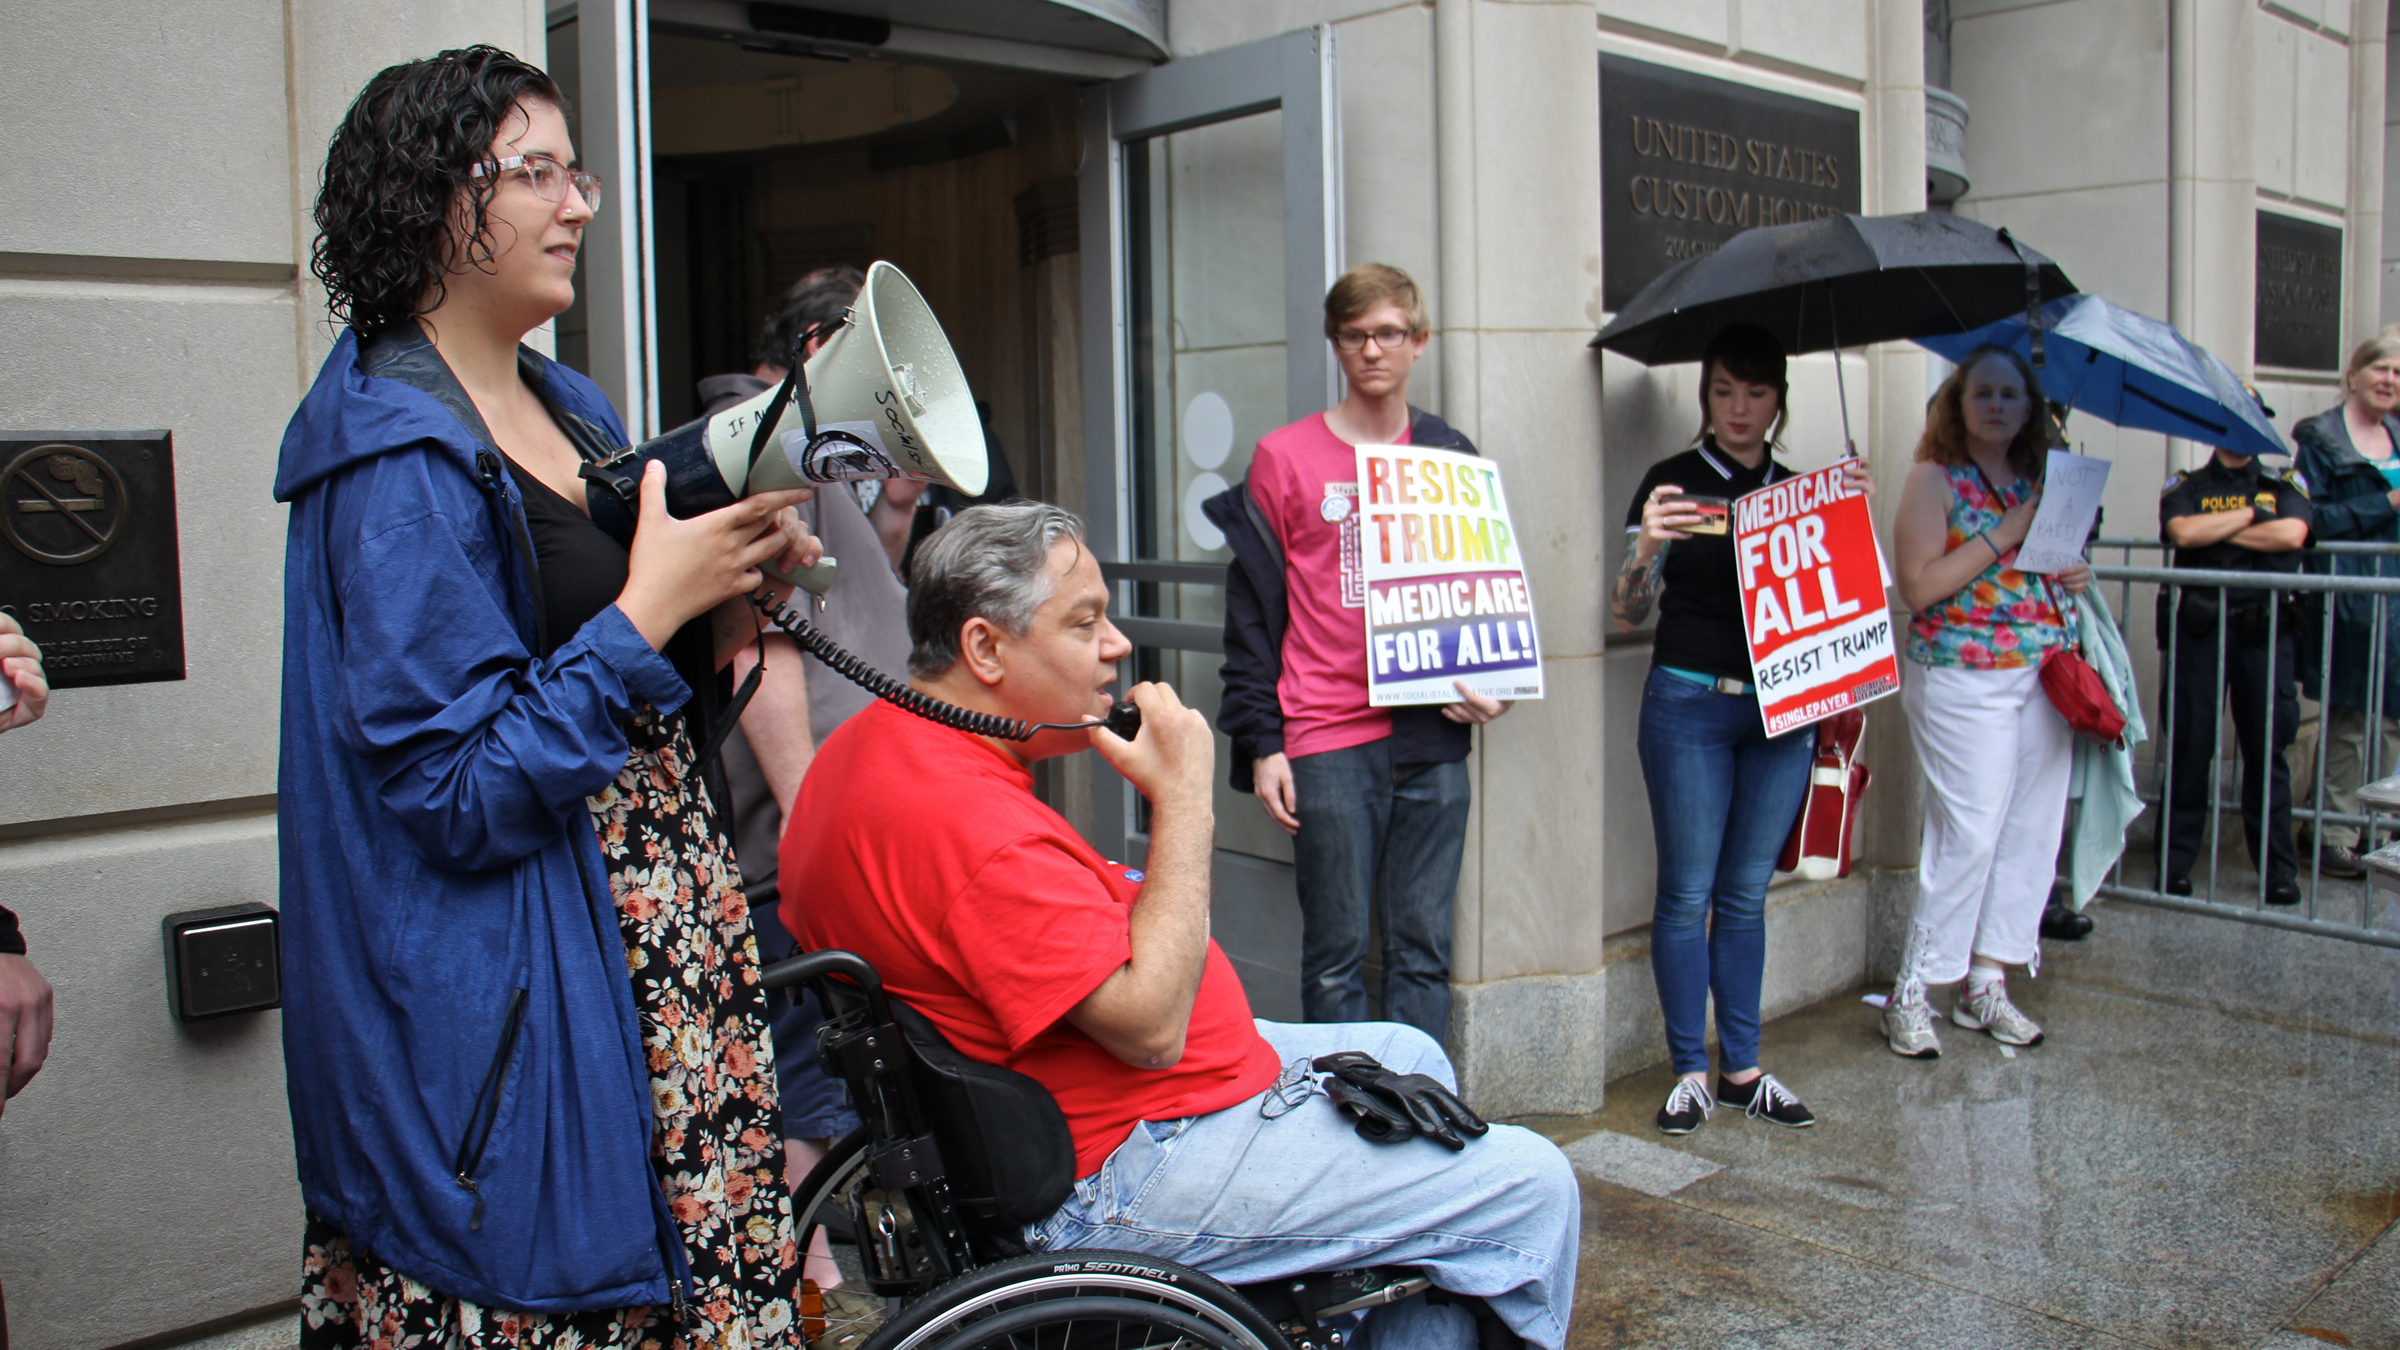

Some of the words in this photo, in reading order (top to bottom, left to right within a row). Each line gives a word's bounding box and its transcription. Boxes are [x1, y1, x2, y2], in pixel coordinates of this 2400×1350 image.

[1632, 115, 1739, 171] UNITED
[1746, 139, 1839, 190] STATES
[1630, 175, 1751, 228] CUSTOM
[1365, 456, 1499, 512] RESIST
[2051, 463, 2097, 488] NOT
[2062, 496, 2073, 514] A
[2201, 494, 2247, 511] POLICE
[1371, 513, 1512, 564] TRUMP
[1740, 514, 1831, 590] FOR
[2036, 519, 2076, 542] PAID
[28, 597, 158, 623] SMOKING
[1369, 577, 1529, 627] MEDICARE
[1752, 565, 1860, 645] ALL
[46, 651, 135, 669] DOORWAYS
[82, 637, 122, 652] FEET
[126, 636, 148, 649] OF
[1373, 628, 1443, 675] FOR
[1456, 620, 1533, 667] ALL!
[1758, 647, 1823, 691] RESIST
[1829, 621, 1888, 664] TRUMP
[1769, 691, 1849, 732] #SINGLEPAYER
[1082, 1261, 1168, 1281] SENTINEL
